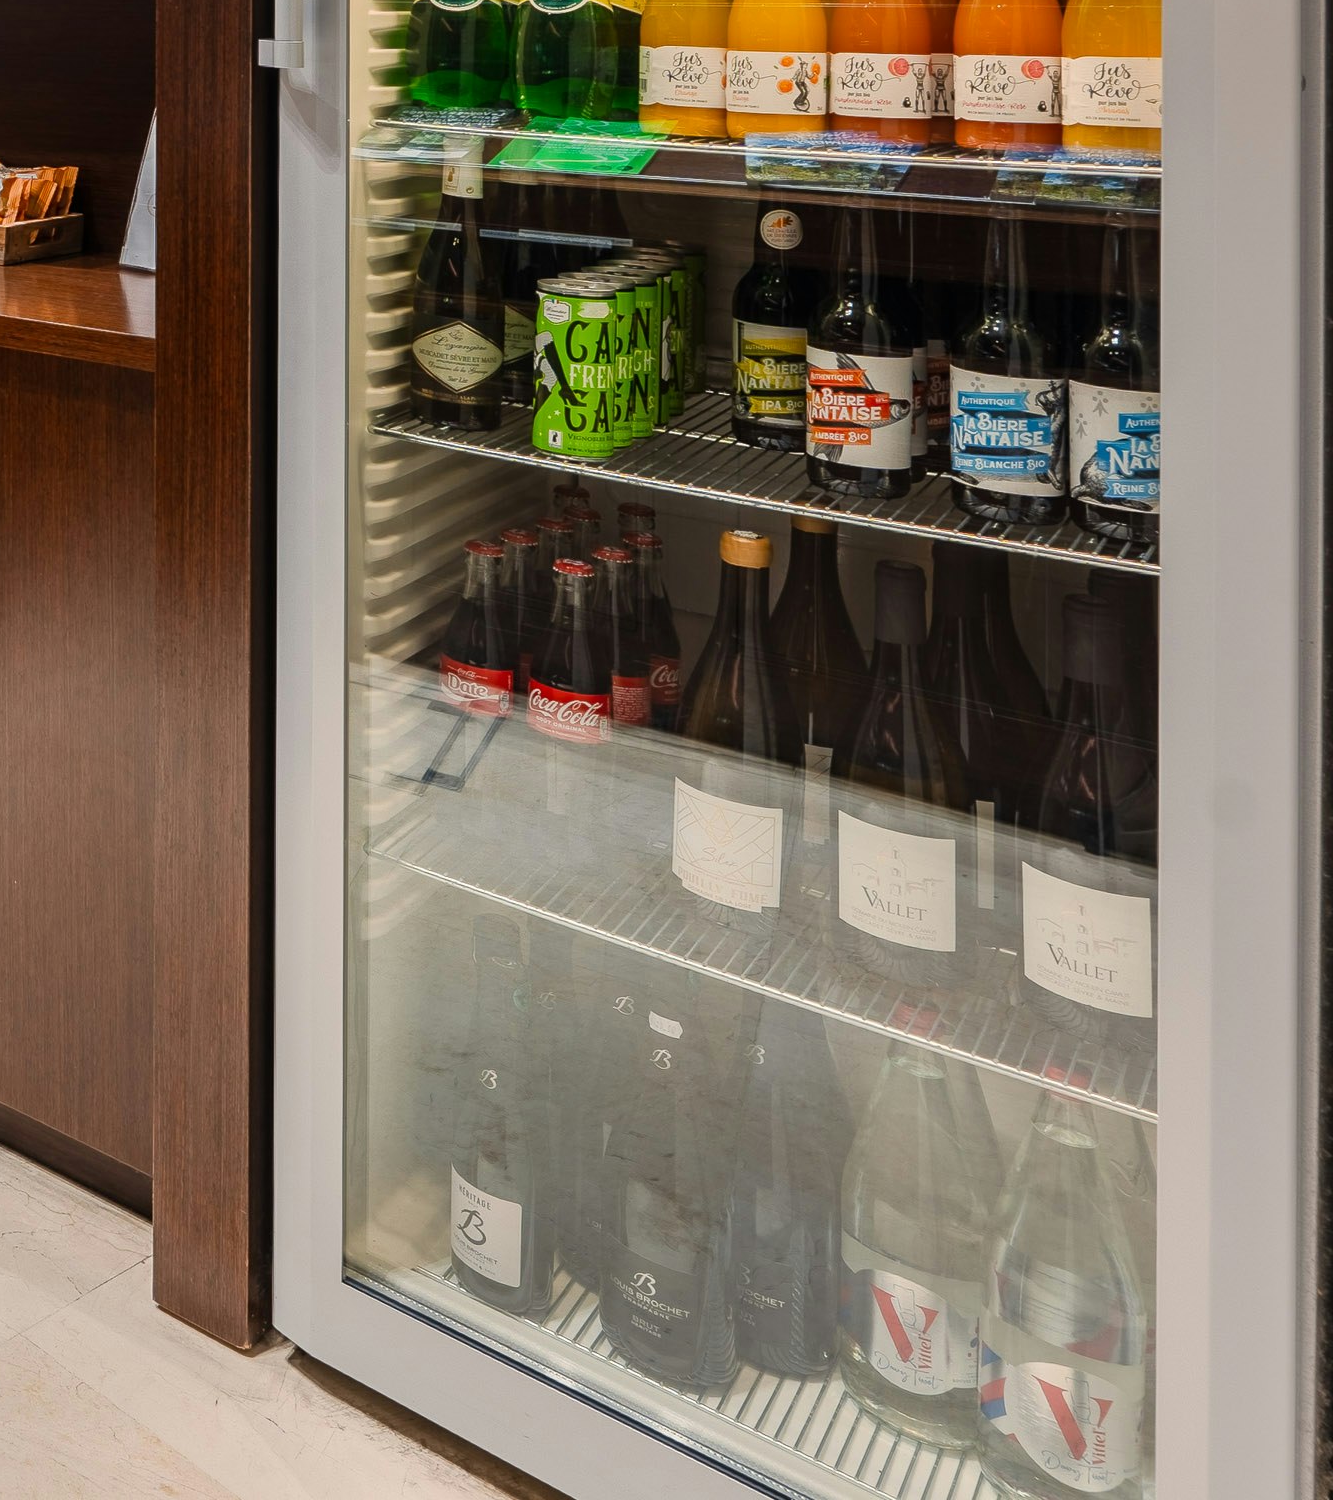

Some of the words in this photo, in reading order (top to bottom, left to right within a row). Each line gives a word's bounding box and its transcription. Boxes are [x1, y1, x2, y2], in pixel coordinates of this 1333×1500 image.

[673, 51, 702, 68] Jus
[845, 56, 875, 75] Jus
[974, 58, 1007, 77] Jus
[1093, 62, 1131, 81] Jus
[751, 360, 763, 375] LA
[810, 372, 854, 382] AUTHENTIQUE
[736, 371, 807, 393] NANTAIS
[761, 399, 781, 411] IPA
[812, 390, 821, 406] LA
[961, 396, 1016, 408] AUTHENTIQUE
[807, 398, 882, 424] NANTAISE
[963, 415, 977, 431] LA
[951, 424, 1045, 449] NANTAISE
[1130, 437, 1147, 453] LA
[953, 454, 973, 468] REINE
[974, 456, 1025, 471] BLANCHE
[1112, 482, 1145, 496] REINE
[447, 672, 489, 699] Date
[527, 687, 603, 729] Coca-Cola
[860, 885, 928, 923] VALLET
[1045, 941, 1119, 985] VALLET
[458, 1185, 492, 1210] HÉRITAGE
[609, 1274, 635, 1297] LOUIS
[635, 1291, 691, 1320] BROCHET
[632, 1314, 661, 1333] BRUT
[917, 1333, 933, 1374] Vittel
[1091, 1427, 1107, 1466] Vittel
